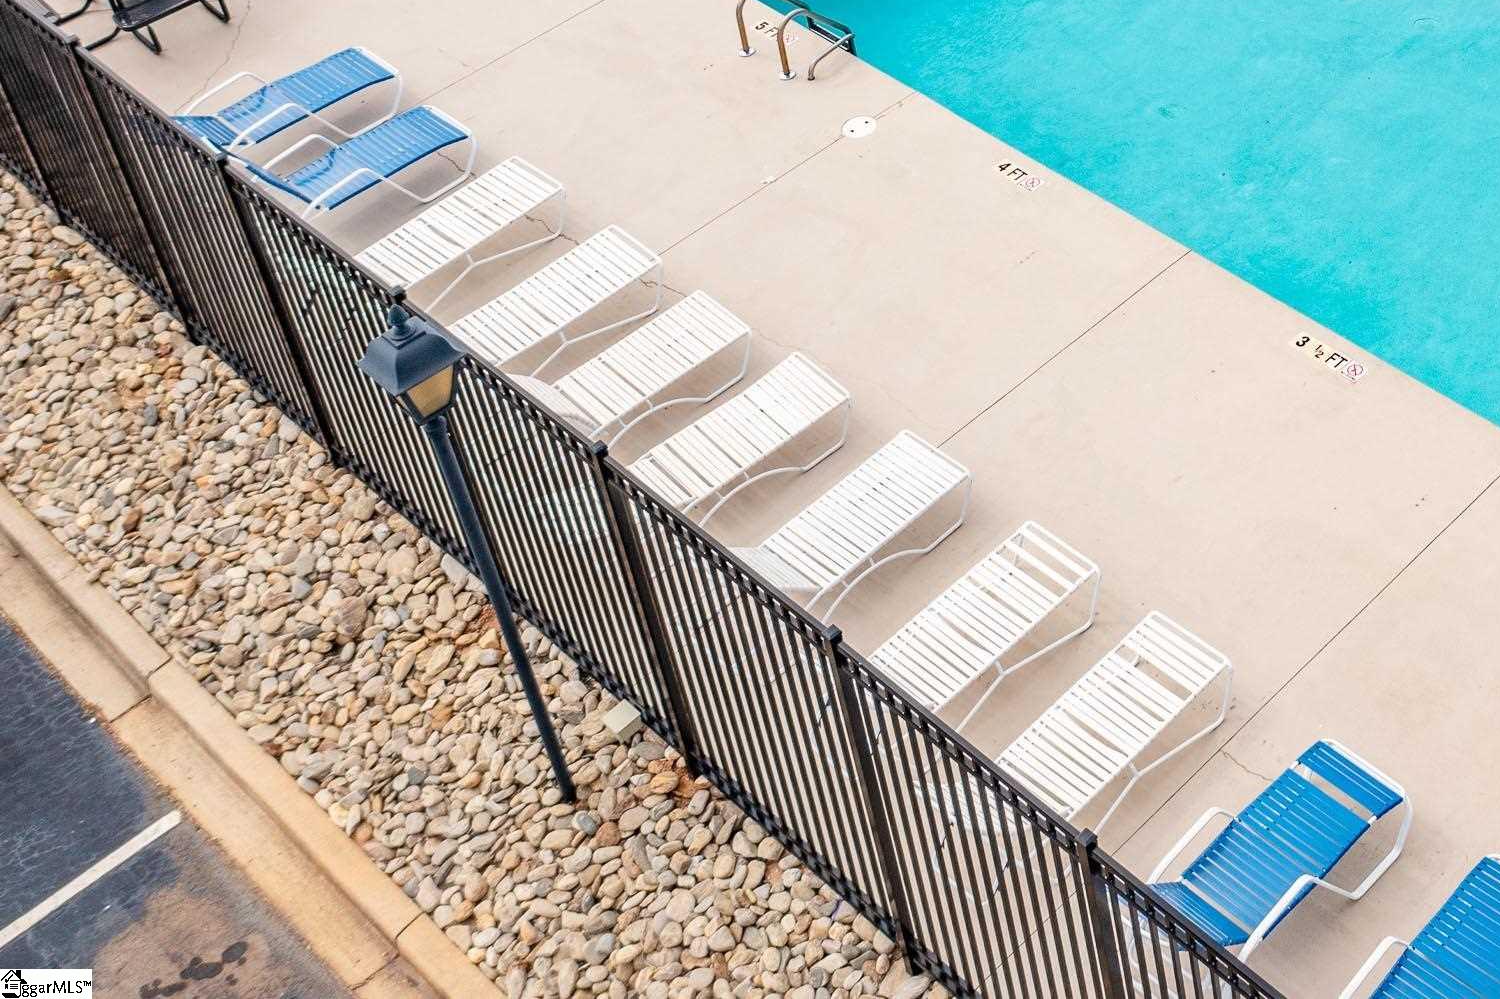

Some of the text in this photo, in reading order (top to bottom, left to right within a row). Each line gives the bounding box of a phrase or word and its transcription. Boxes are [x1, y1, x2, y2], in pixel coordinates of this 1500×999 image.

[998, 163, 1028, 180] 4 FT
[1295, 336, 1310, 347] 3
[1325, 352, 1348, 368] FT
